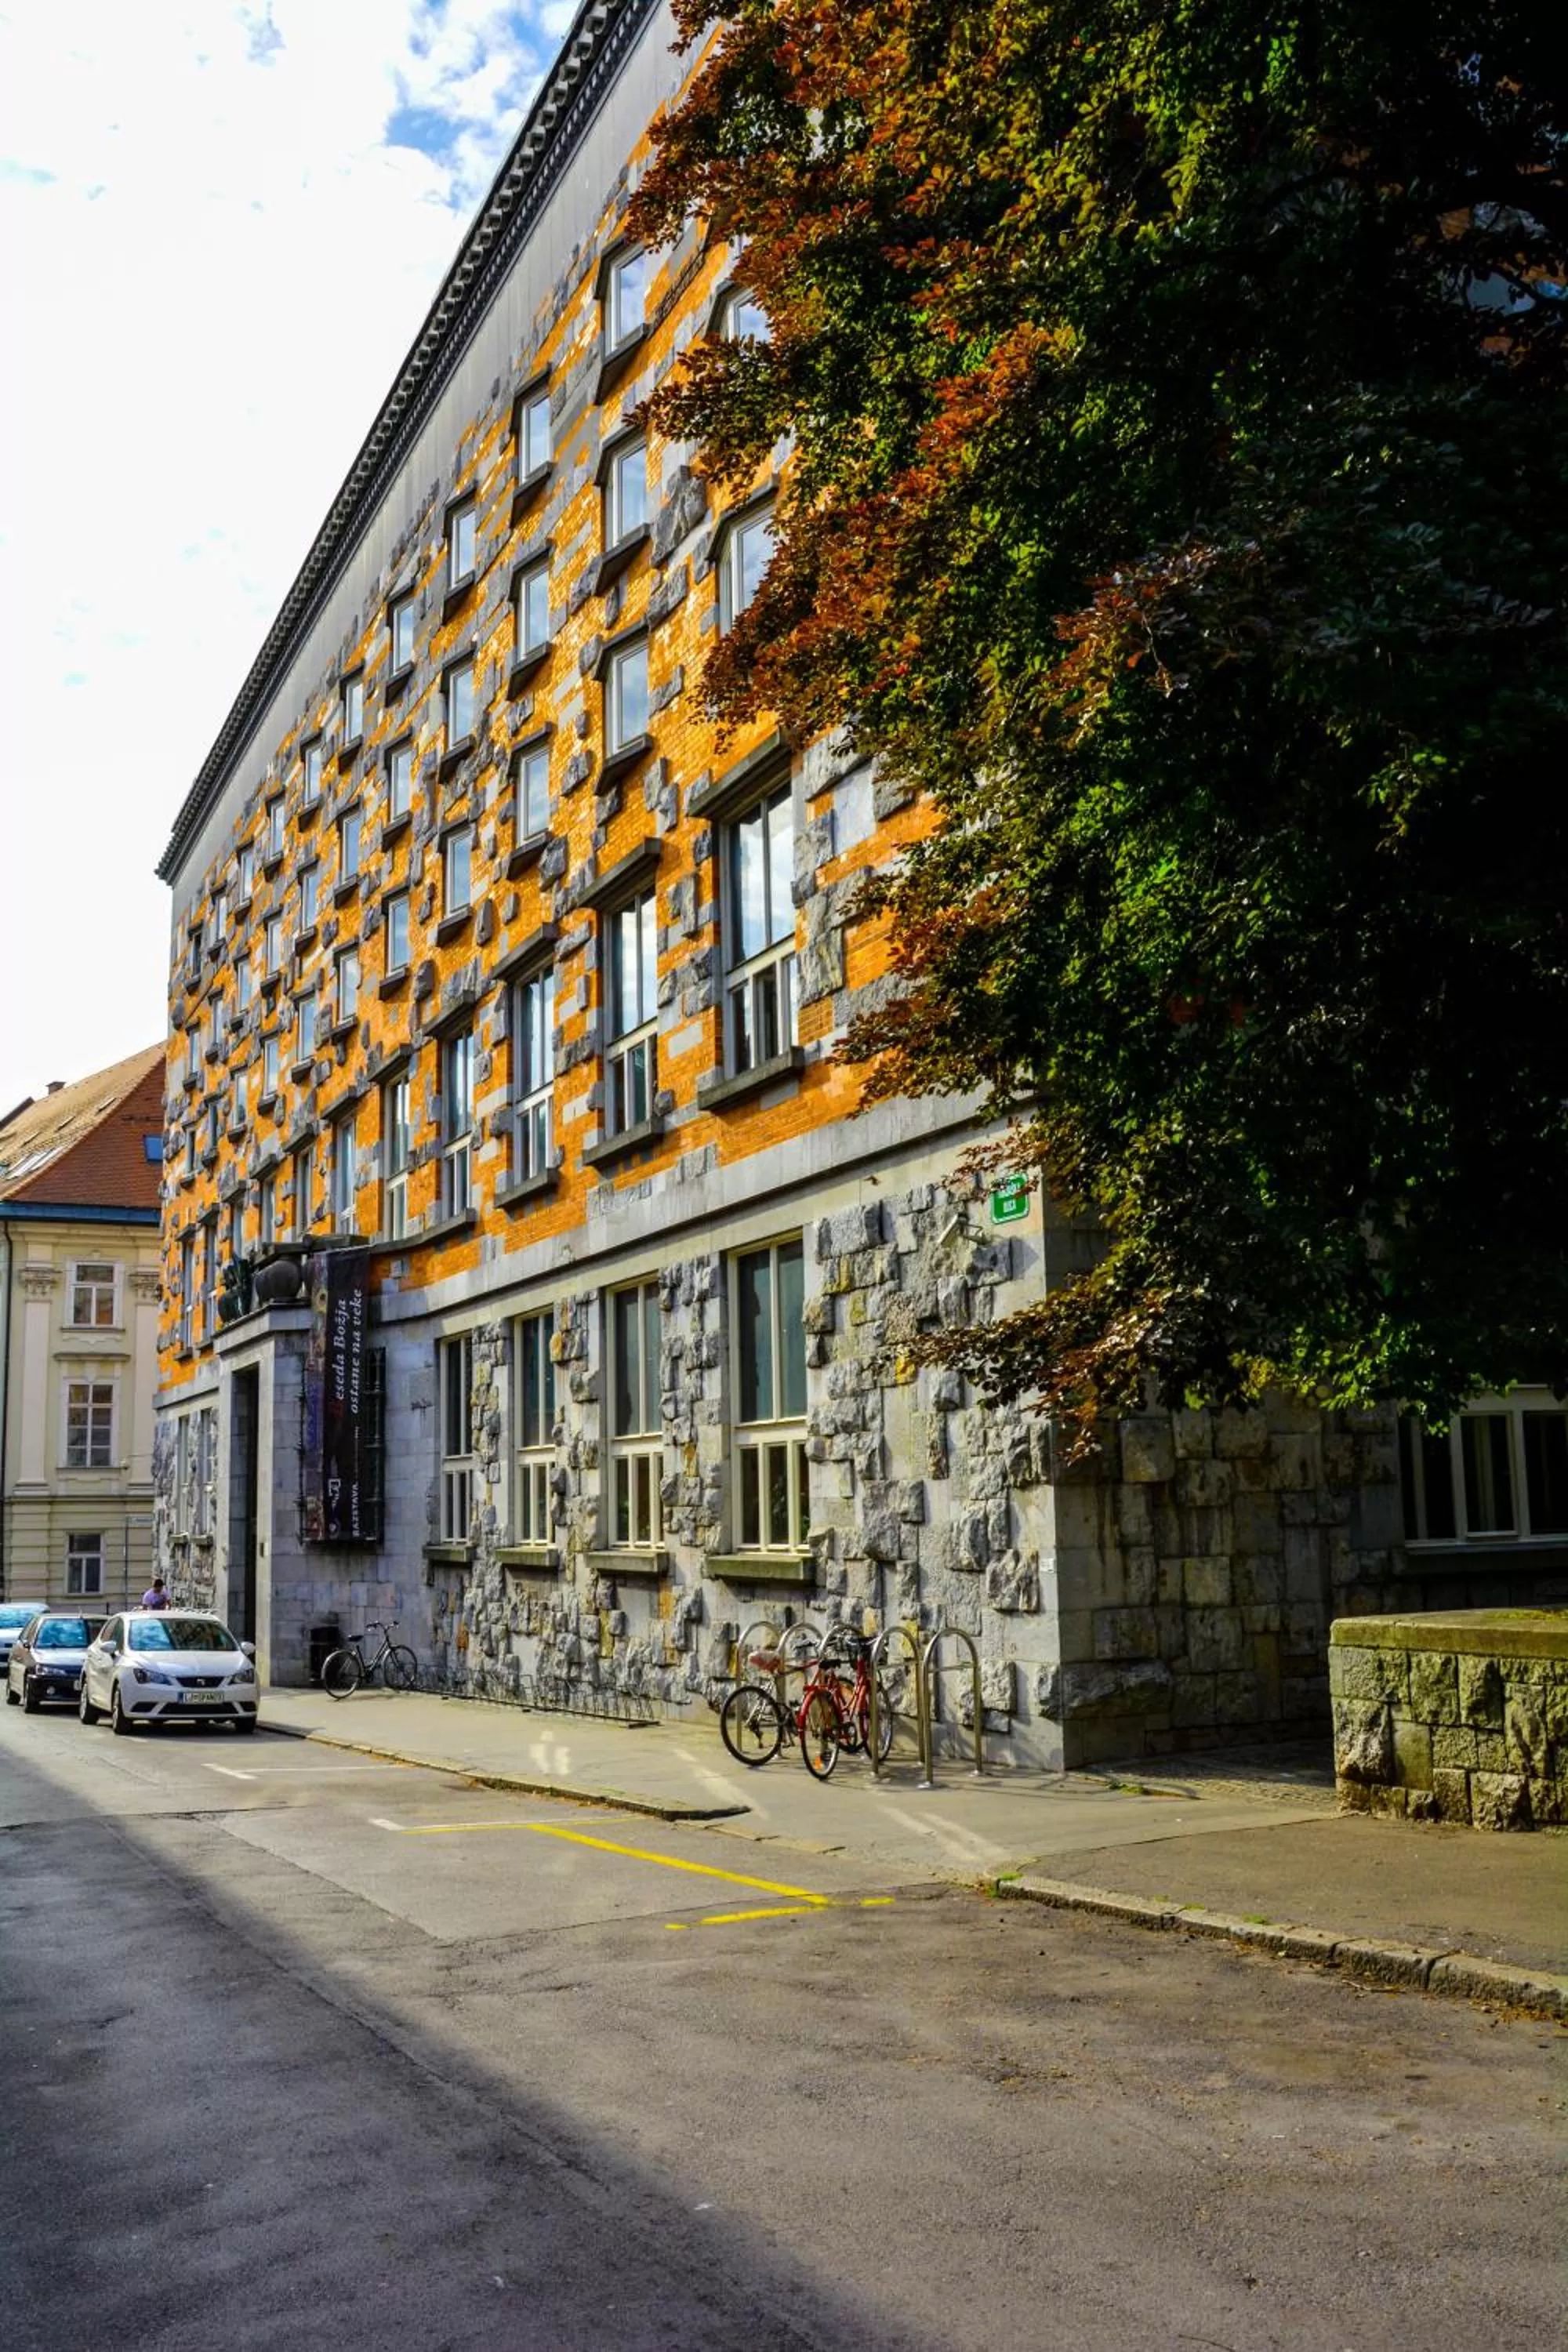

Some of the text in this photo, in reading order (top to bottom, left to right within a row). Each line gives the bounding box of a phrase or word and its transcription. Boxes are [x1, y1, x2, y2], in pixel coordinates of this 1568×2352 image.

[334, 1298, 350, 1349] Božja
[350, 1288, 363, 1326] veke
[352, 1330, 361, 1353] na
[350, 1357, 361, 1414] ostane
